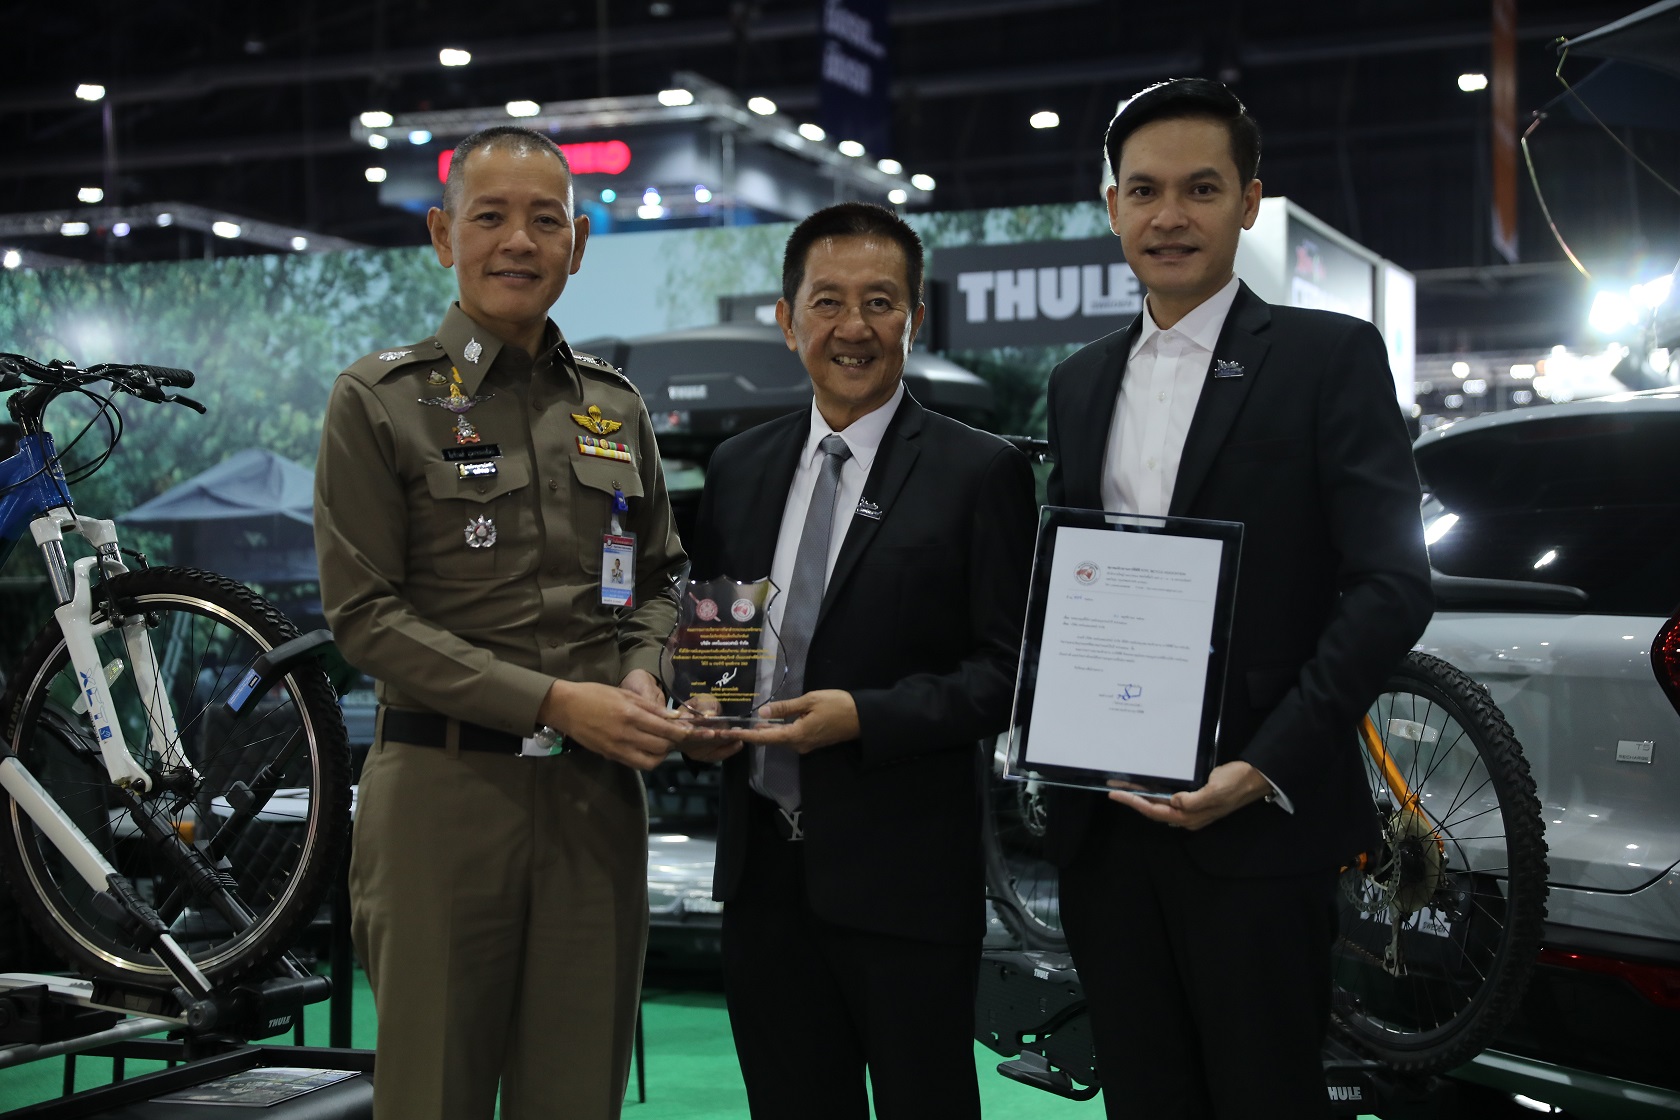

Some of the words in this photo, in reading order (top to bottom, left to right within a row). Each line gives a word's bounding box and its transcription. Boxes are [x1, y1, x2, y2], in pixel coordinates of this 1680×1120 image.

[957, 262, 1143, 323] THULE
[268, 1015, 291, 1028] THULE
[1327, 1086, 1362, 1101] HULE
